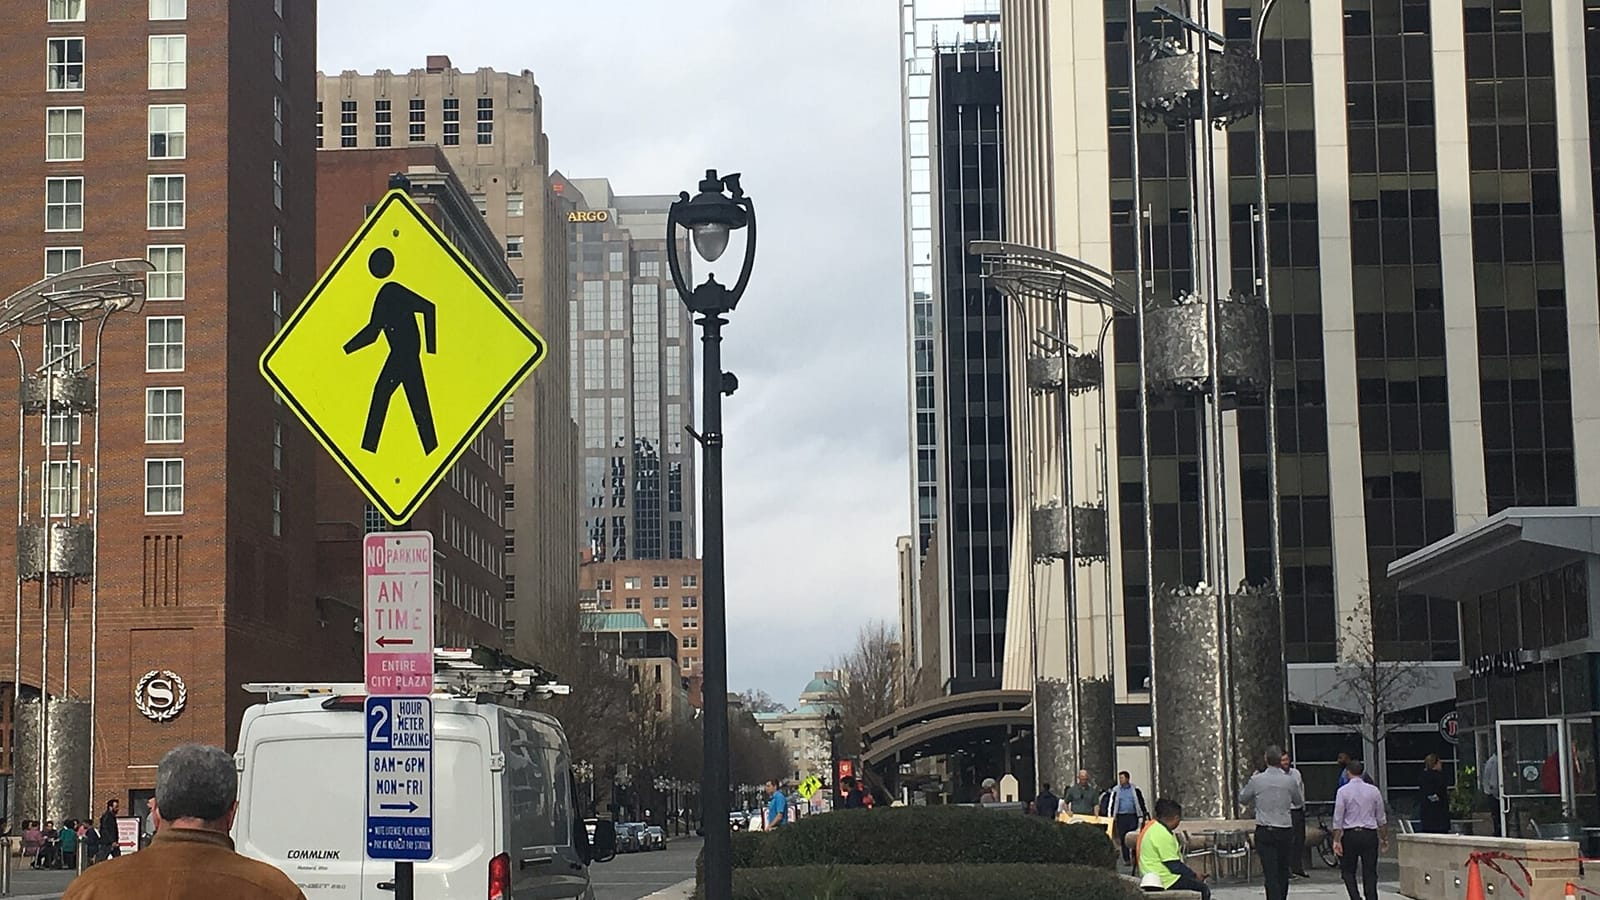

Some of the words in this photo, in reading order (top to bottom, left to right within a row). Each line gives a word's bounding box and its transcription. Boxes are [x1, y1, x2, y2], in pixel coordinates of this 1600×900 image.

[567, 211, 608, 222] ARGO
[367, 546, 384, 567] NO
[387, 548, 428, 564] PARKING
[375, 609, 422, 630] TIME
[381, 660, 416, 672] ENTIRE
[371, 676, 392, 688] CITY
[395, 676, 427, 688] PLAZA
[148, 680, 174, 707] S
[399, 702, 422, 715] HOUR
[370, 705, 389, 743] 2
[398, 717, 424, 731] METER
[393, 733, 430, 746] PARKING
[287, 850, 340, 859] COMMLINK
